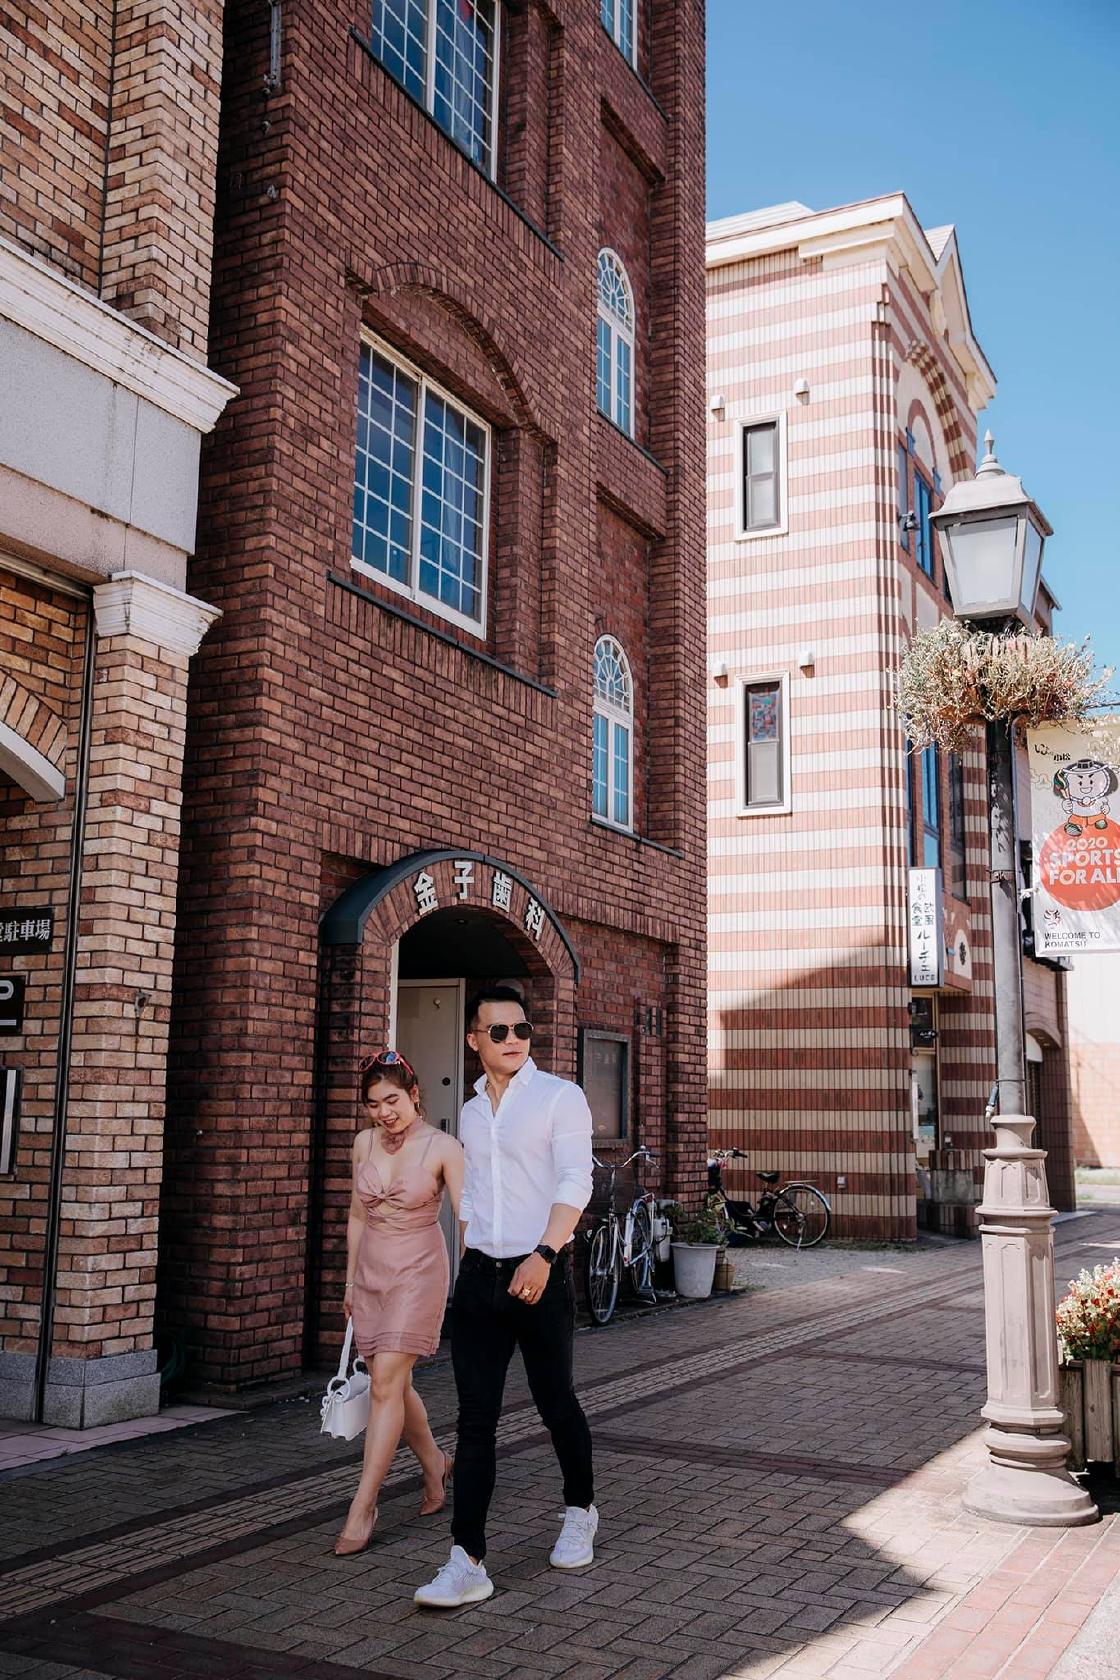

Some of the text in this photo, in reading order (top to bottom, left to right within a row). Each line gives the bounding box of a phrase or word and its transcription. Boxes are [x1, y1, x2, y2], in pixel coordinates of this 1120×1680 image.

[1066, 836, 1108, 852] 2020
[1049, 869, 1088, 885] FOR
[413, 860, 545, 941] 金子歯科
[1044, 931, 1101, 940] WELCOME TO
[1044, 940, 1087, 949] KOMATSU
